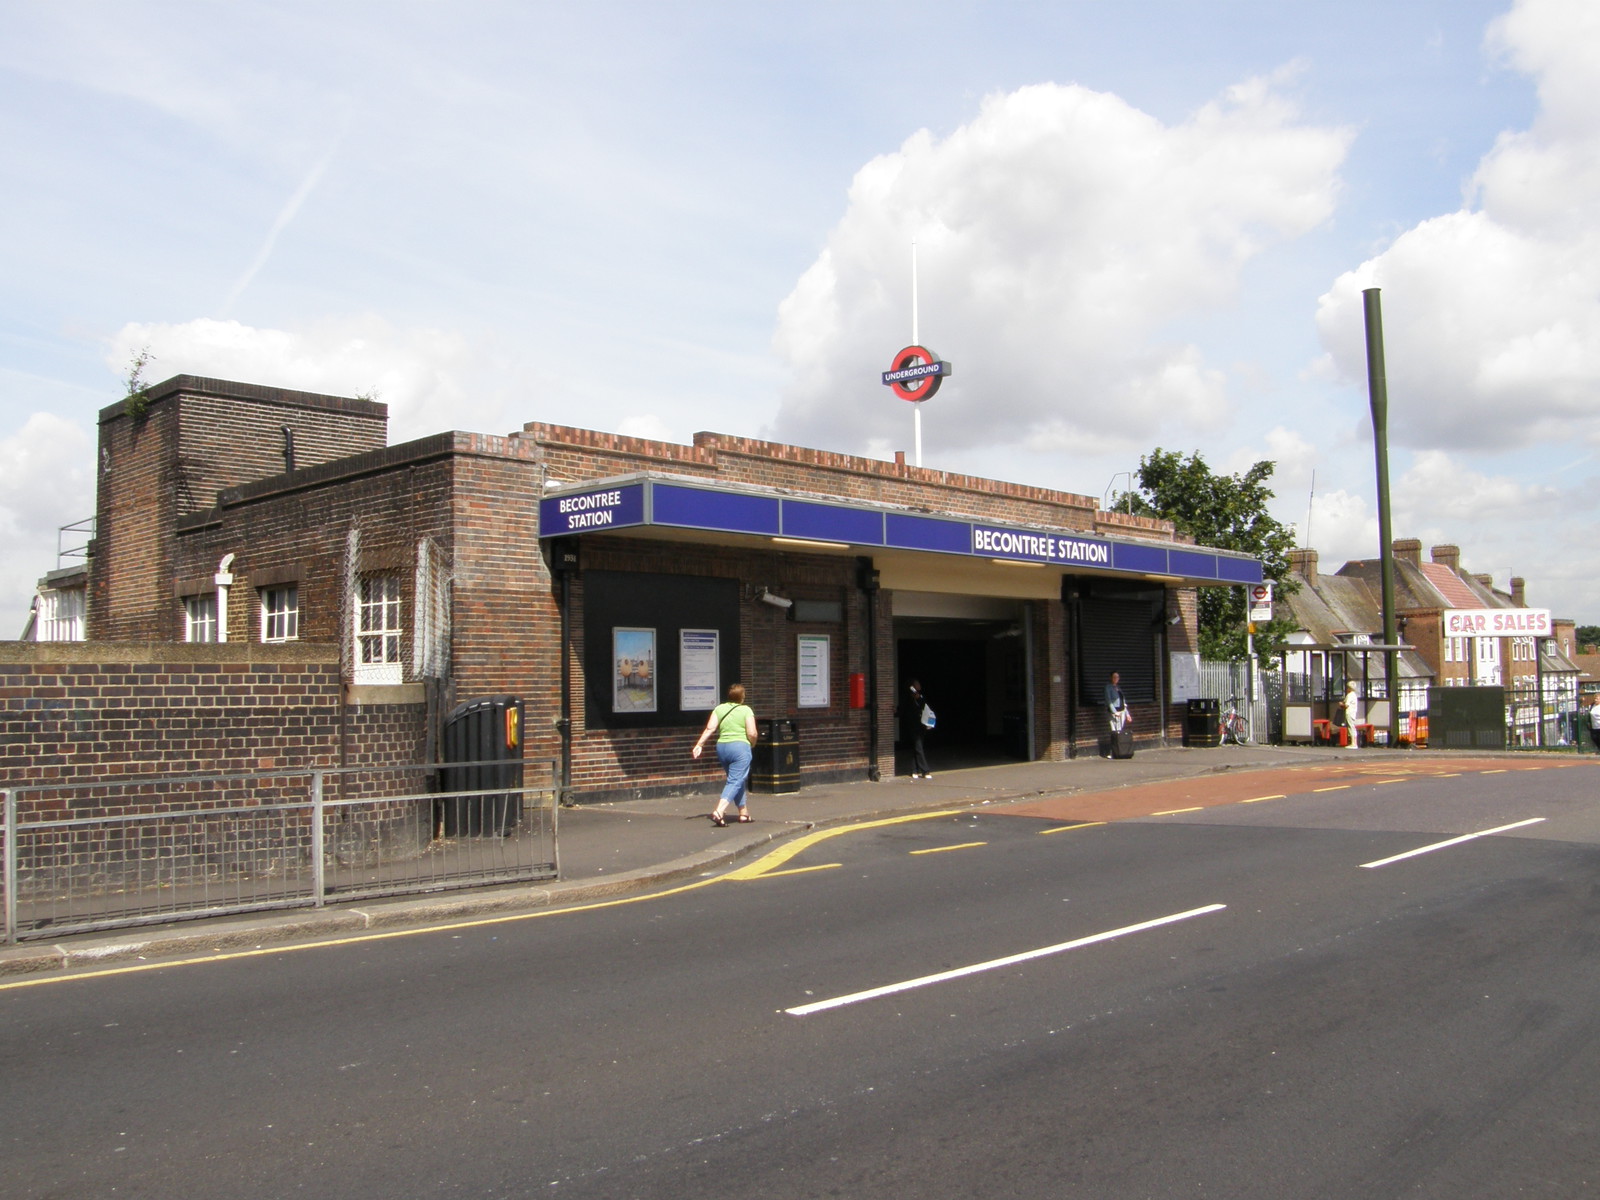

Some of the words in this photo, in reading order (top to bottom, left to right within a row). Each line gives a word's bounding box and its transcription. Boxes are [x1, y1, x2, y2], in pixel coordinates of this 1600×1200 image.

[885, 365, 939, 381] UNDERGROUND
[560, 491, 621, 513] BECONTREE
[568, 510, 612, 529] STATION
[975, 529, 1056, 557] BECONTREE
[1058, 540, 1107, 562] STATION
[1450, 615, 1486, 632] CAR
[1494, 614, 1547, 631] SALES
